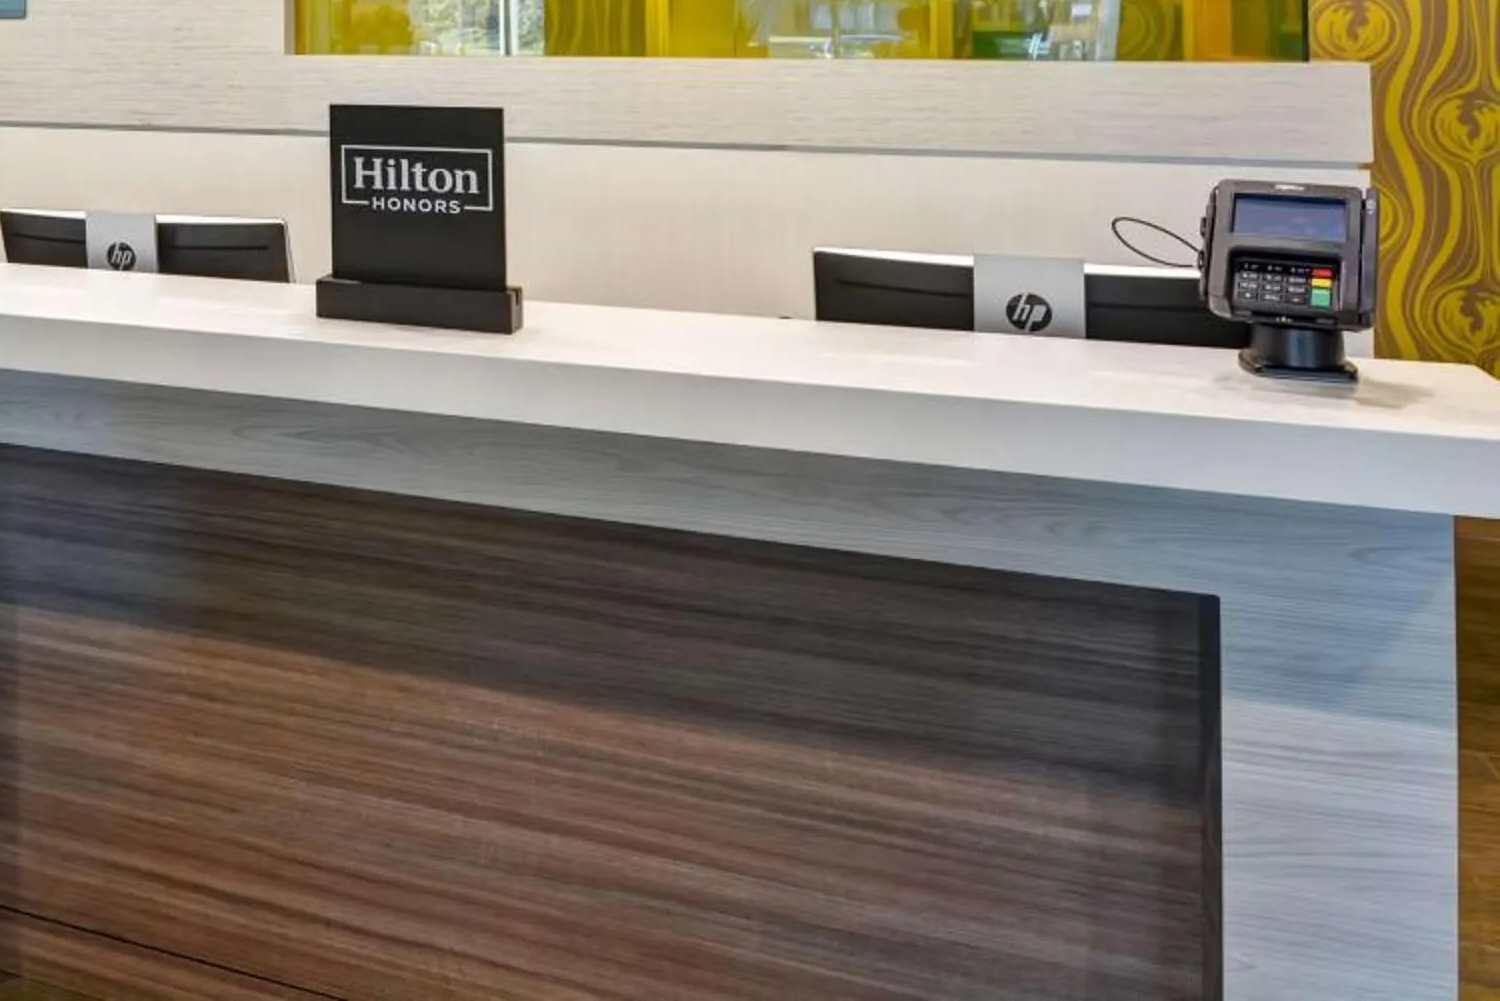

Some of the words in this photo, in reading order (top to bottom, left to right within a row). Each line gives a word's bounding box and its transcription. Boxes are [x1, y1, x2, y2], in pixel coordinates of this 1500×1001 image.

[353, 156, 480, 195] Hilton
[371, 196, 462, 215] HONORS
[109, 241, 134, 271] hp
[1010, 293, 1049, 332] hp
